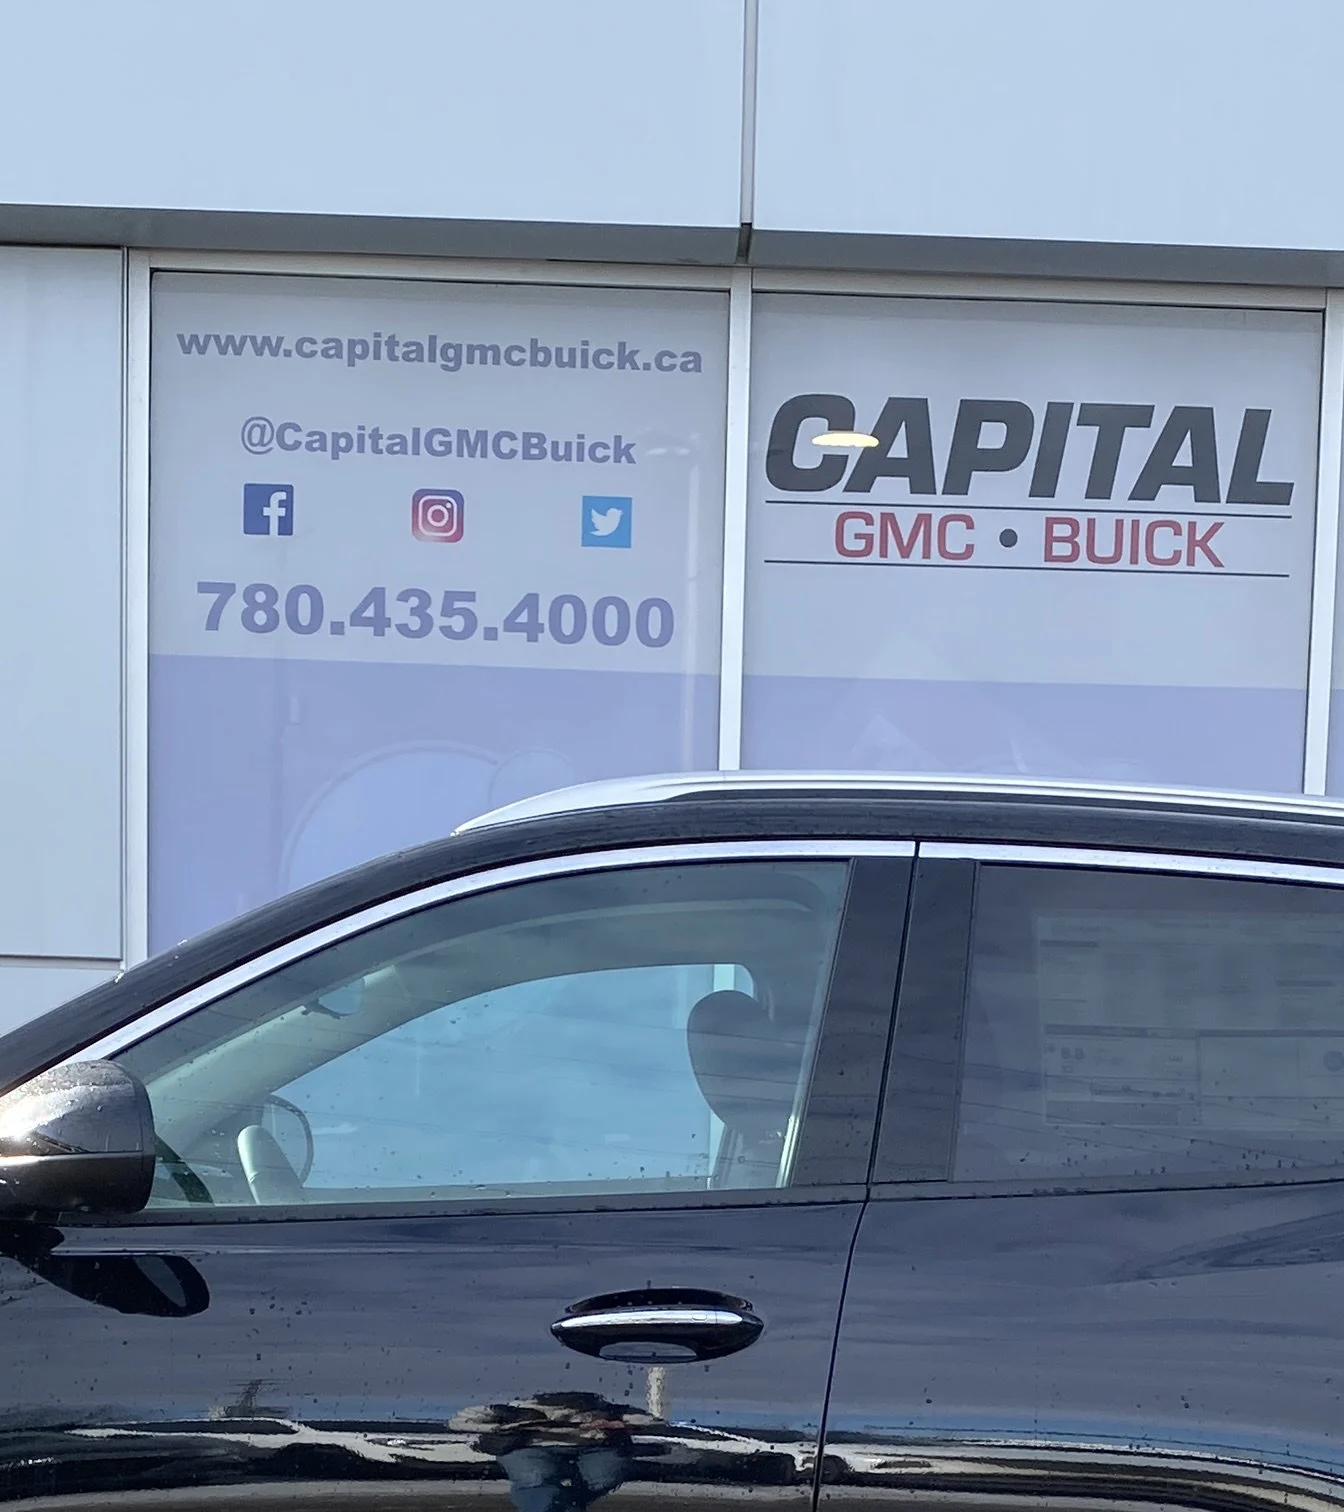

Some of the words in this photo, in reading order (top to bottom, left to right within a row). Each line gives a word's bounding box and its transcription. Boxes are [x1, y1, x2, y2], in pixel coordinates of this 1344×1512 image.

[176, 331, 703, 374] www.capitalgmcbuick.ca
[240, 415, 636, 465] @CapitalGMCBuick
[764, 393, 1295, 506] CAPITAL
[834, 511, 975, 561] GMC
[1043, 517, 1226, 568] BUICK
[196, 581, 675, 648] 780.435.4000
